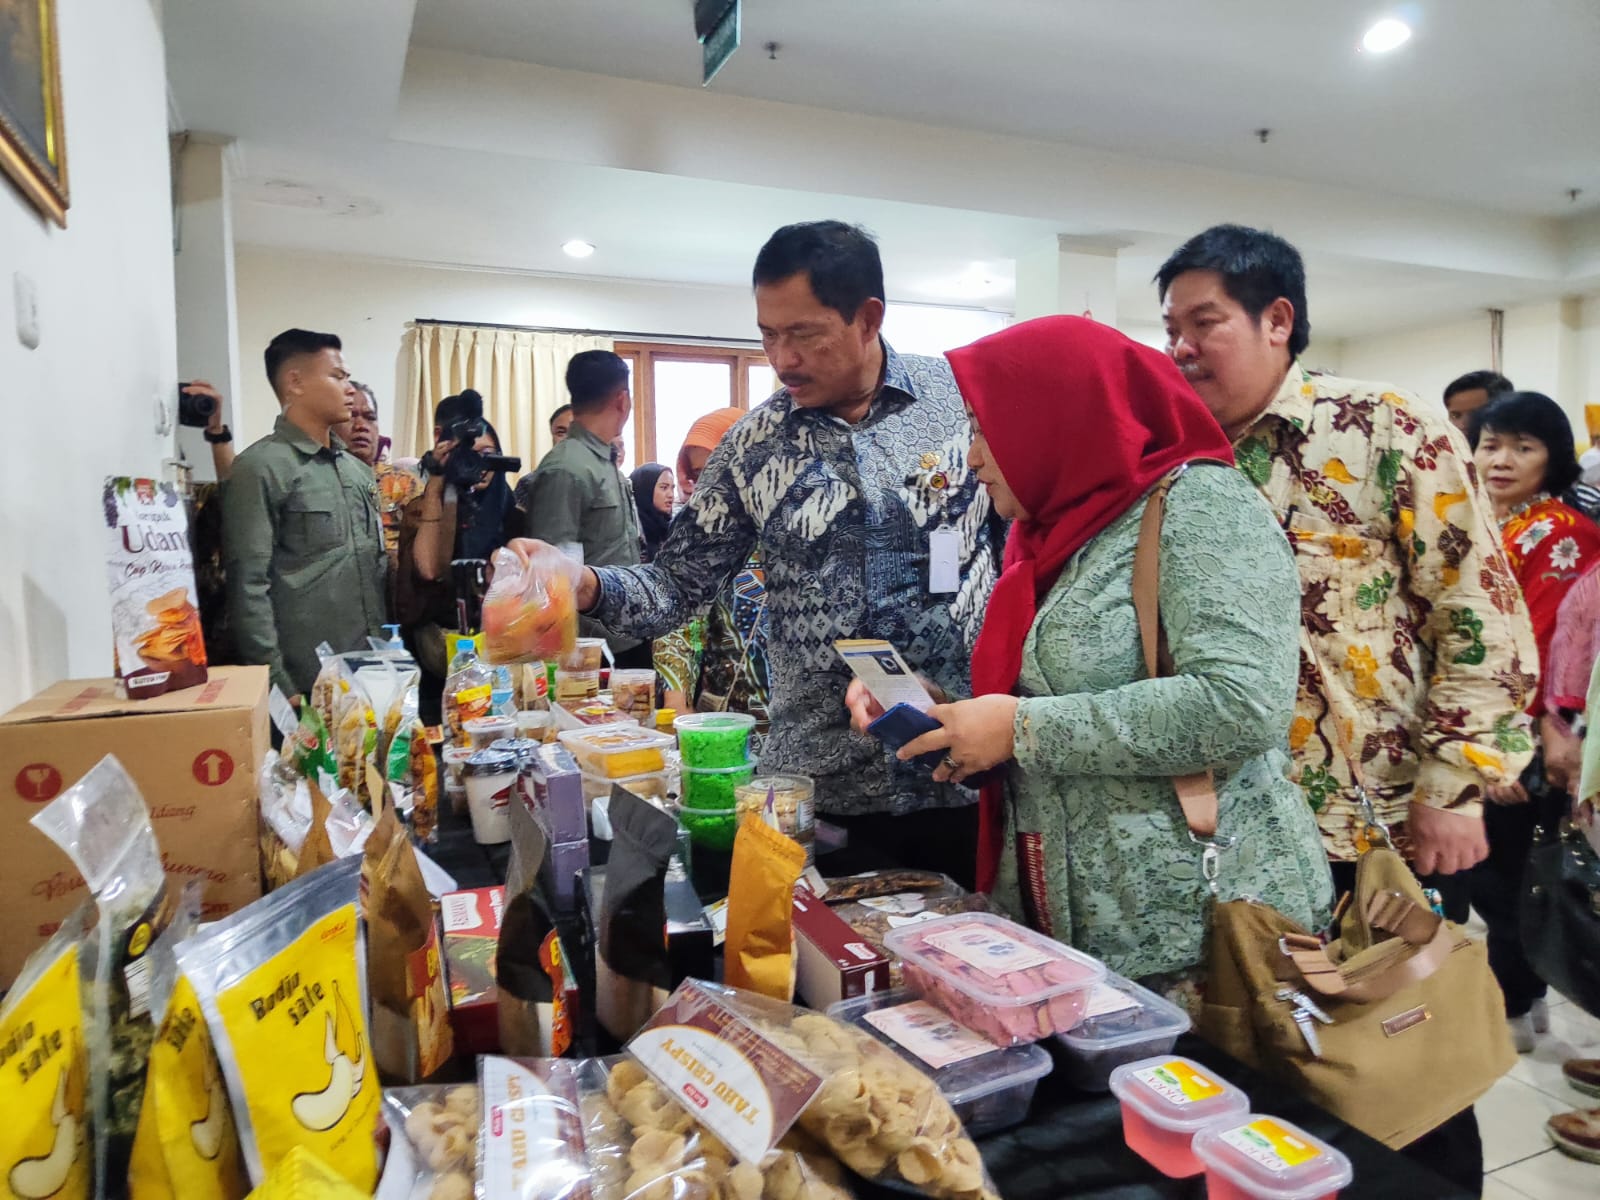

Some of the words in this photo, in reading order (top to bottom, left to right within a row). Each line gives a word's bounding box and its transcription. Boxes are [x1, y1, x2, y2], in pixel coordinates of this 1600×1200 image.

[119, 524, 187, 553] Udan
[288, 982, 325, 1027] sale
[0, 1020, 35, 1068] odjo
[18, 1029, 62, 1084] sale
[660, 1037, 716, 1087] CRISPY
[713, 1080, 761, 1126] TAHU
